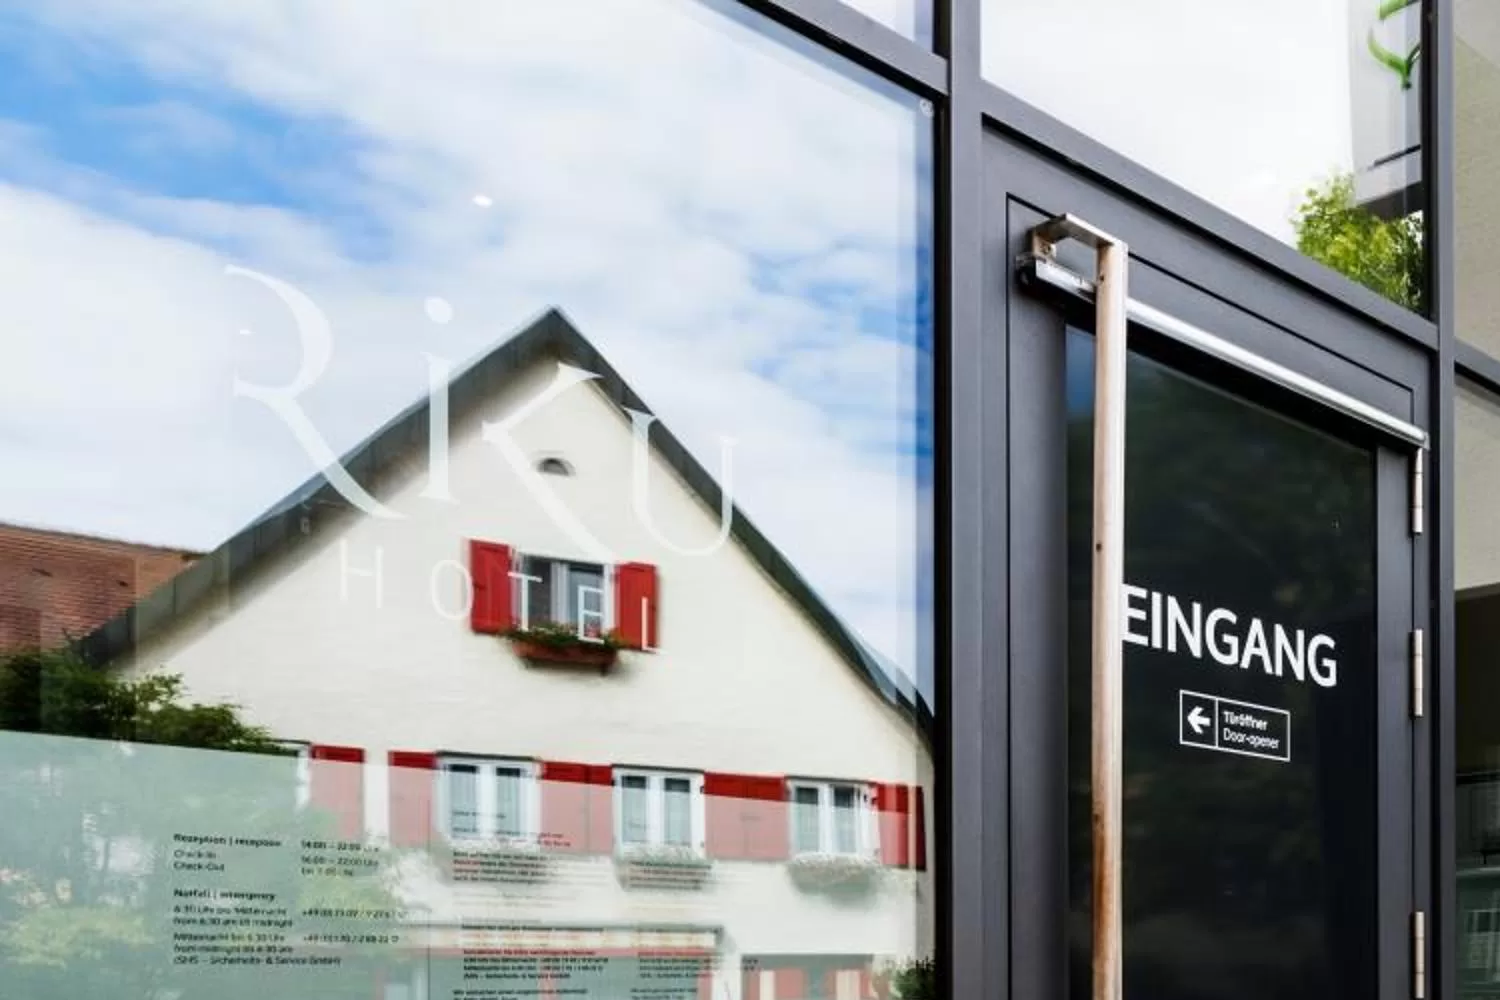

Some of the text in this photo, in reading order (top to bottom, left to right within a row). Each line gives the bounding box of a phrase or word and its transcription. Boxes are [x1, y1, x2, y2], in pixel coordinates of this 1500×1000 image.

[339, 538, 668, 656] HOTEL
[1121, 583, 1338, 688] EINGANG
[1222, 710, 1269, 731] Türöffner
[1222, 727, 1280, 750] Door-opener
